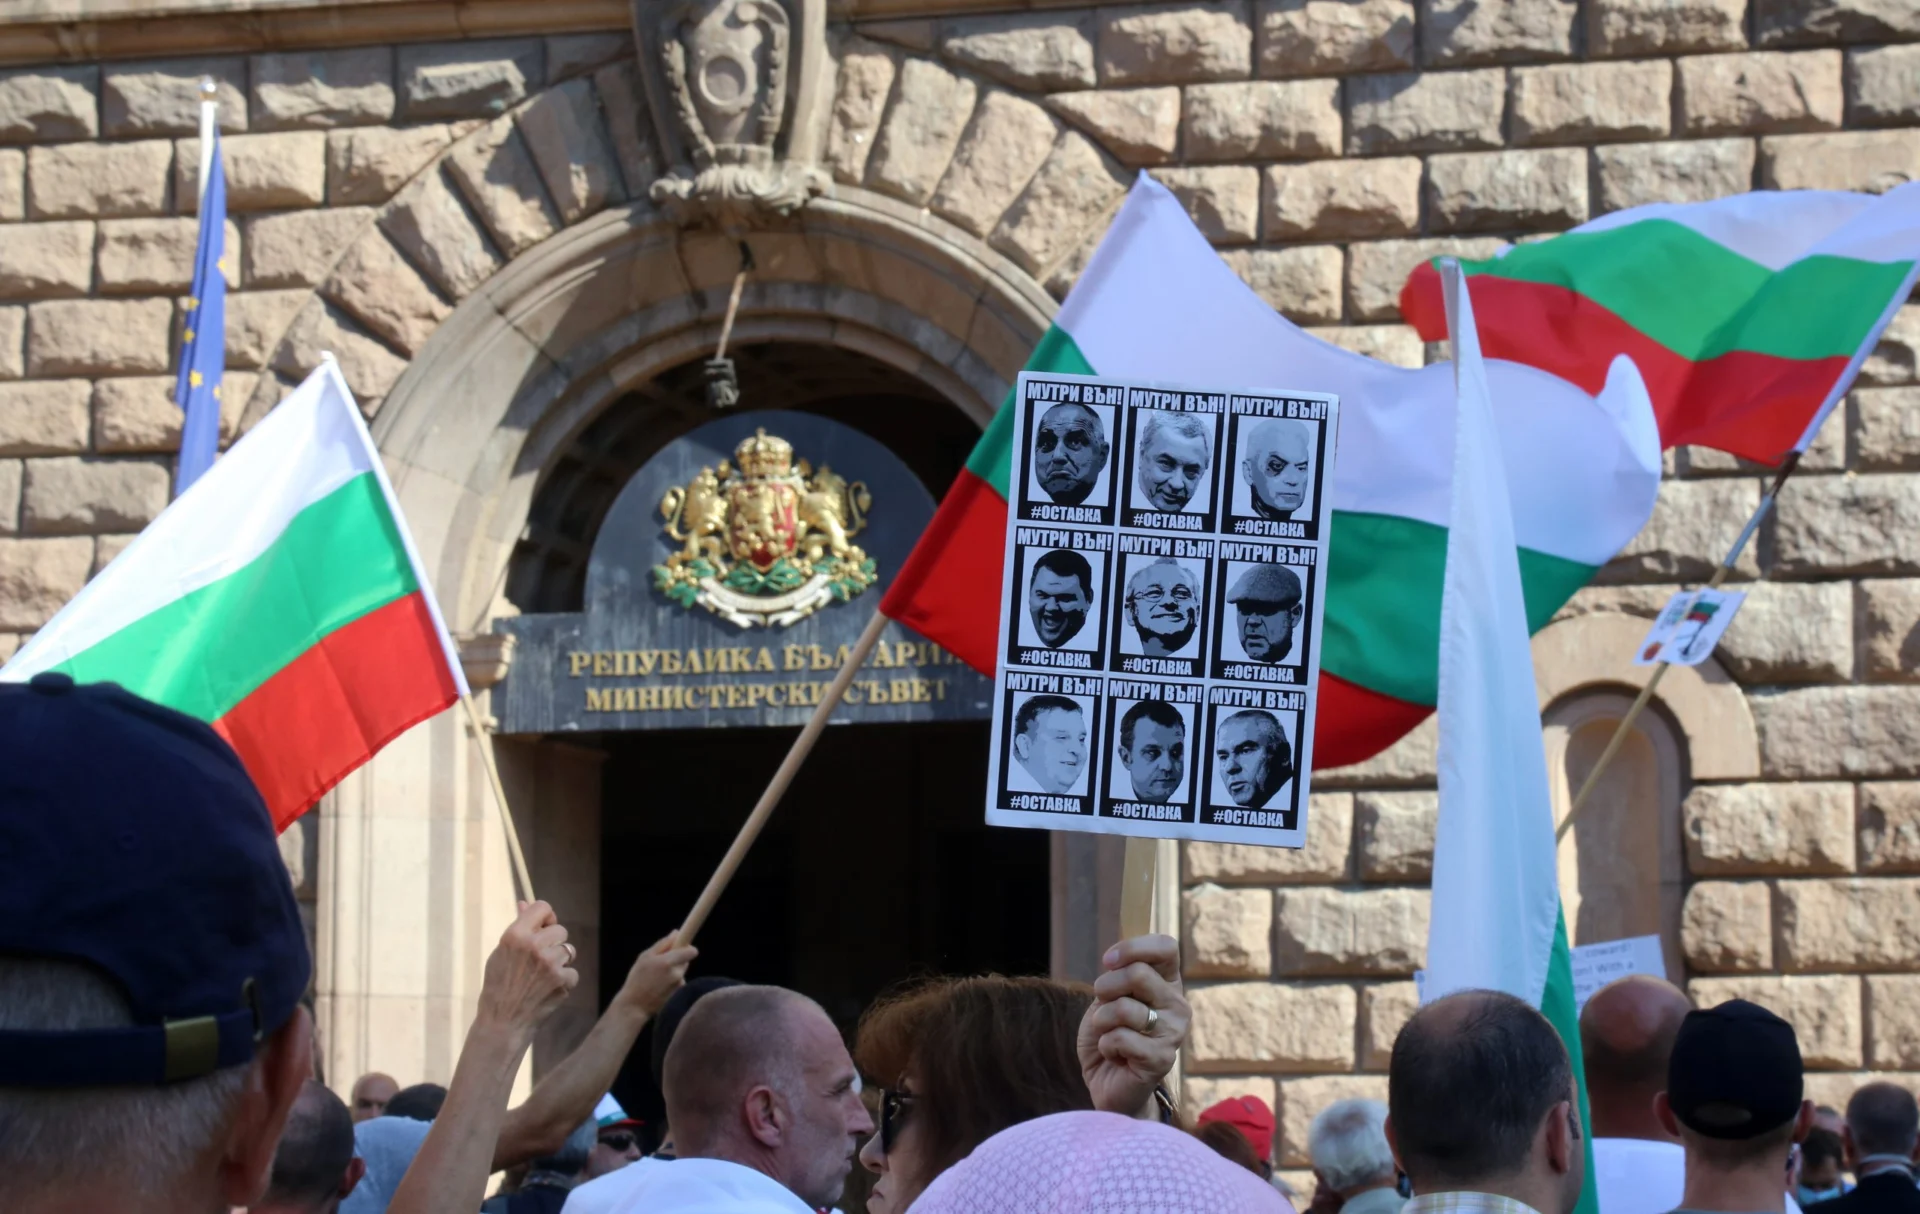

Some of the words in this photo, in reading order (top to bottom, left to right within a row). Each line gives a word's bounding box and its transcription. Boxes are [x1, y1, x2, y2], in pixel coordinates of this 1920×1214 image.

[1027, 382, 1080, 402] МУТРИ
[1083, 386, 1123, 405] ВЪН!
[1129, 390, 1181, 410] МУТРИ
[1184, 393, 1224, 413] ВЪН!
[1231, 397, 1283, 417] МУТРИ
[1287, 400, 1327, 420] ВЪН!
[1031, 505, 1101, 523] #ОСТАВКА
[1133, 512, 1203, 530] #ОСТАВКА
[1017, 527, 1069, 548] МУТРИ
[1072, 532, 1112, 551] ВЪН!
[1234, 519, 1305, 538] #ОСТАВКА
[1119, 535, 1170, 556] МУТРИ
[1174, 539, 1213, 558] ВЪН!
[1220, 542, 1273, 563] МУТРИ
[1276, 546, 1316, 566] ВЪН!
[568, 647, 775, 677] РЕПУБЛИКА
[784, 642, 964, 671] БЪЛАРИ
[1021, 651, 1091, 668] #ОСТАВКА
[1123, 658, 1192, 676] #ОСТАВКА
[1006, 672, 1059, 693] МУТРИ
[1062, 676, 1102, 696] ВЪН!
[1224, 664, 1294, 683] #ОСТАВКА
[585, 680, 831, 712] МИНИСТЕРСКИ
[843, 677, 948, 704] СЪВЕТ
[1109, 680, 1160, 701] МУТРИ
[1164, 684, 1203, 703] ВЪН!
[1209, 687, 1262, 708] МУТРИ
[1265, 691, 1305, 710] ВЪН!
[1010, 794, 1081, 813] #ОСТАВКА
[1112, 802, 1182, 821] #ОСТАВКА
[1213, 809, 1284, 828] #ОСТАВКА
